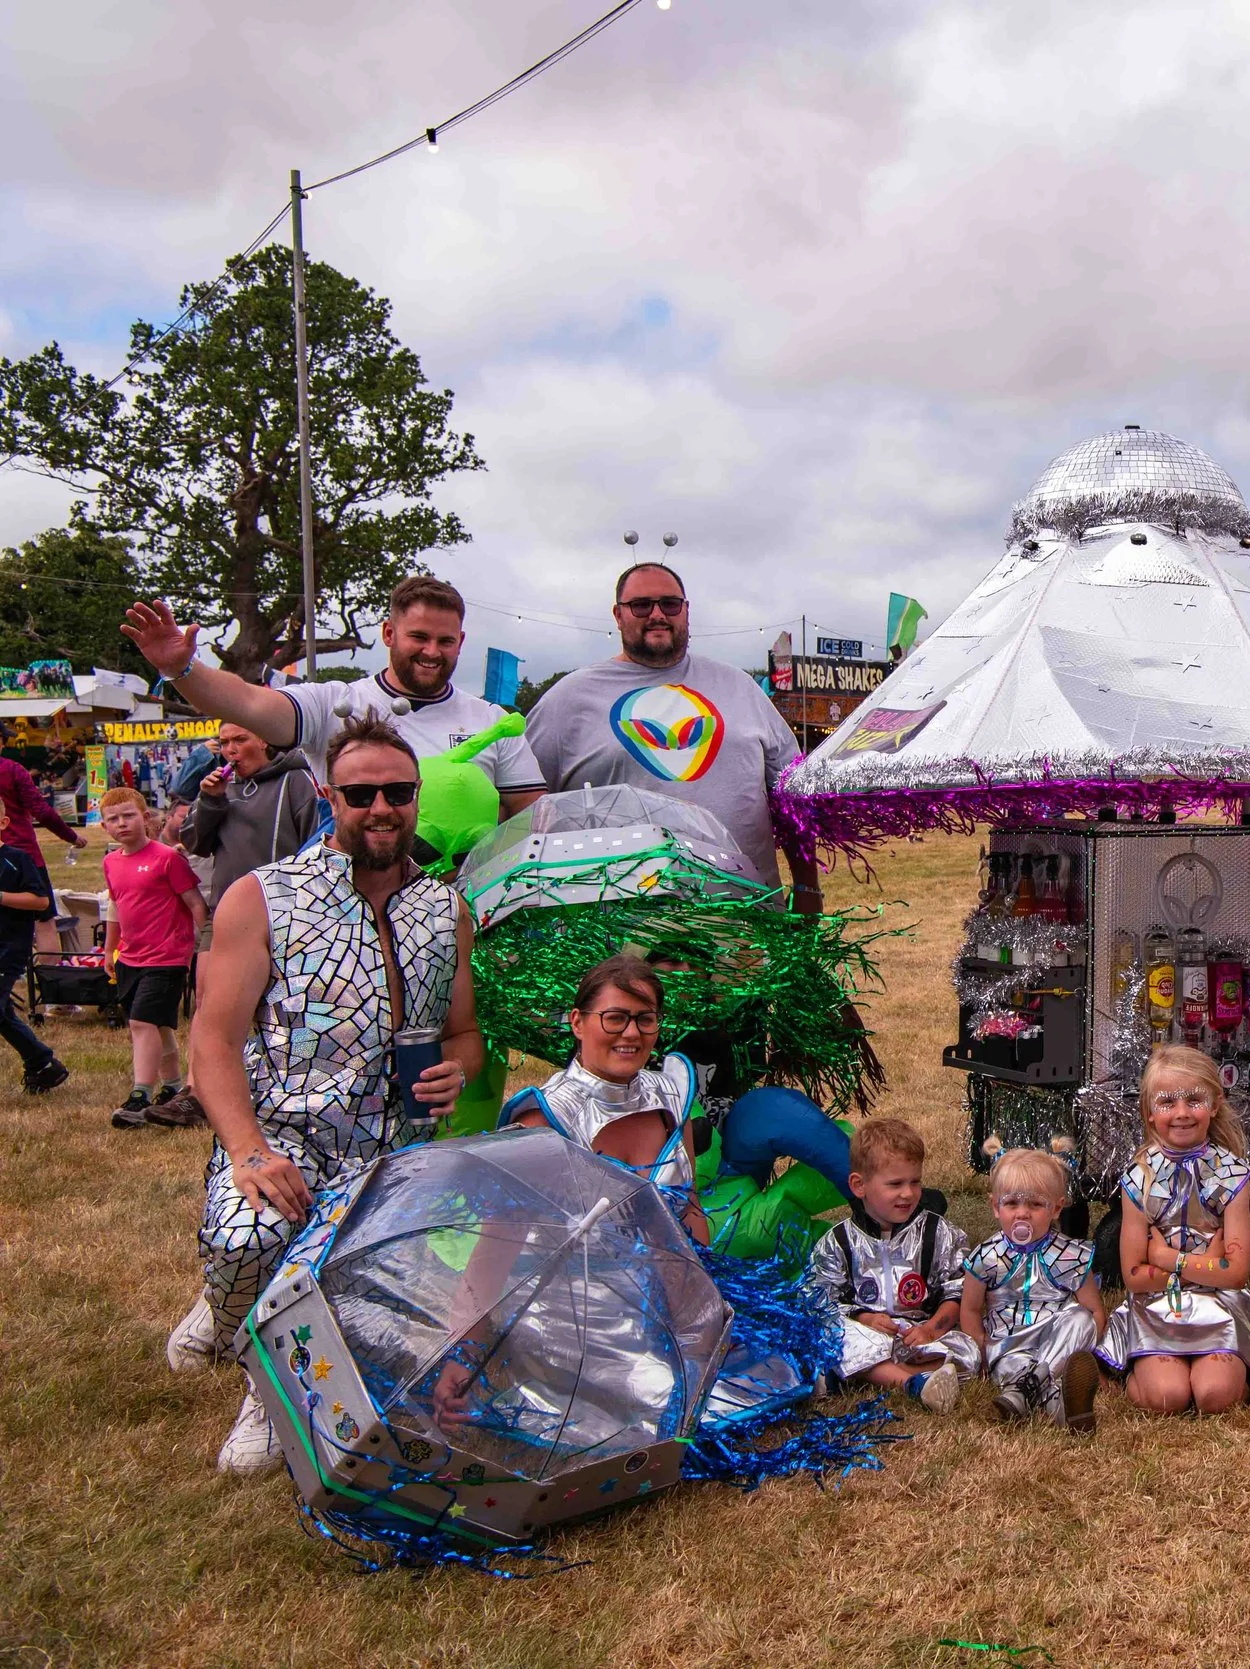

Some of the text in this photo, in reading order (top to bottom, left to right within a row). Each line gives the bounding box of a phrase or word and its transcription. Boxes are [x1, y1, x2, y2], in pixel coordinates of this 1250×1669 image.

[820, 638, 860, 654] ICE COLD
[797, 663, 883, 692] MEGA SHAKES
[105, 722, 171, 743] PENALTY
